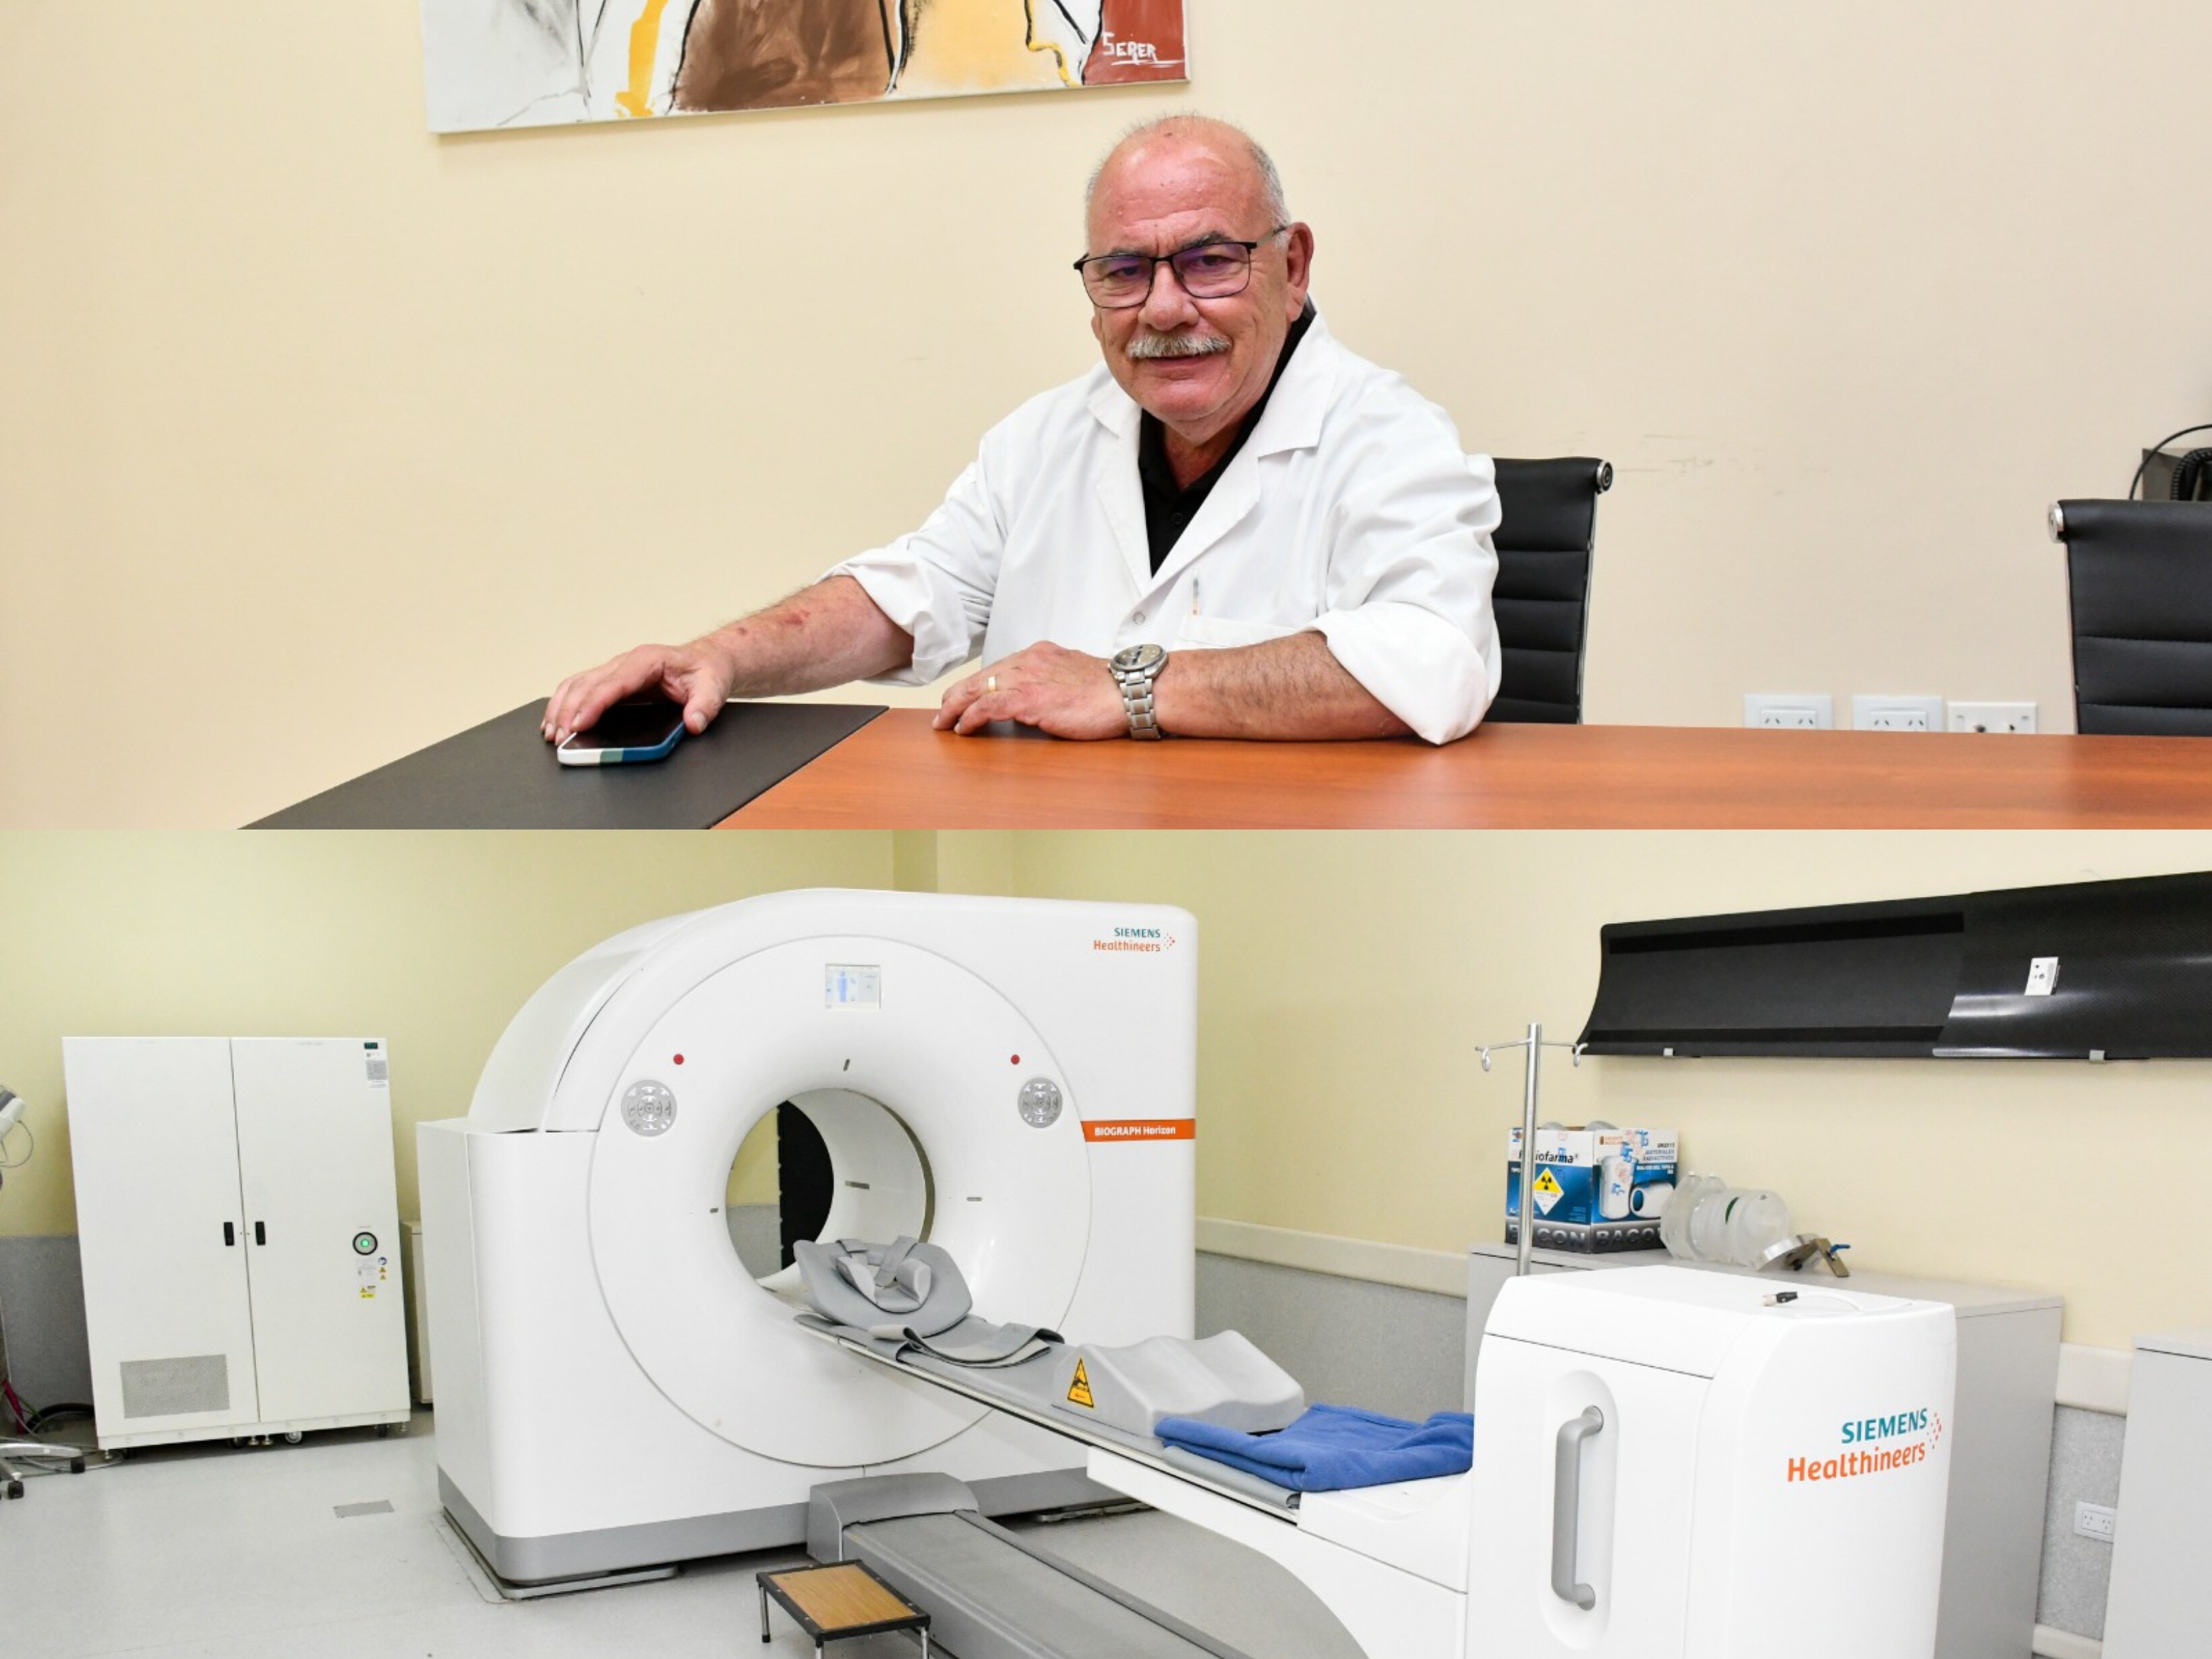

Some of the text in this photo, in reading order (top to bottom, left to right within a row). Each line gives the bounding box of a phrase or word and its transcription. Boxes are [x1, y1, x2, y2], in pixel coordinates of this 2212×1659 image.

[1114, 927, 1161, 938] SIEMENS
[1093, 940, 1161, 952] Healthineers
[1095, 1126, 1176, 1136] BIOGRAPH Horizon
[1509, 1224, 1585, 1247] BCON
[1596, 1227, 1661, 1246] BACO
[1841, 1408, 1927, 1444] SIEMENS
[1787, 1443, 1925, 1482] Healthineers
